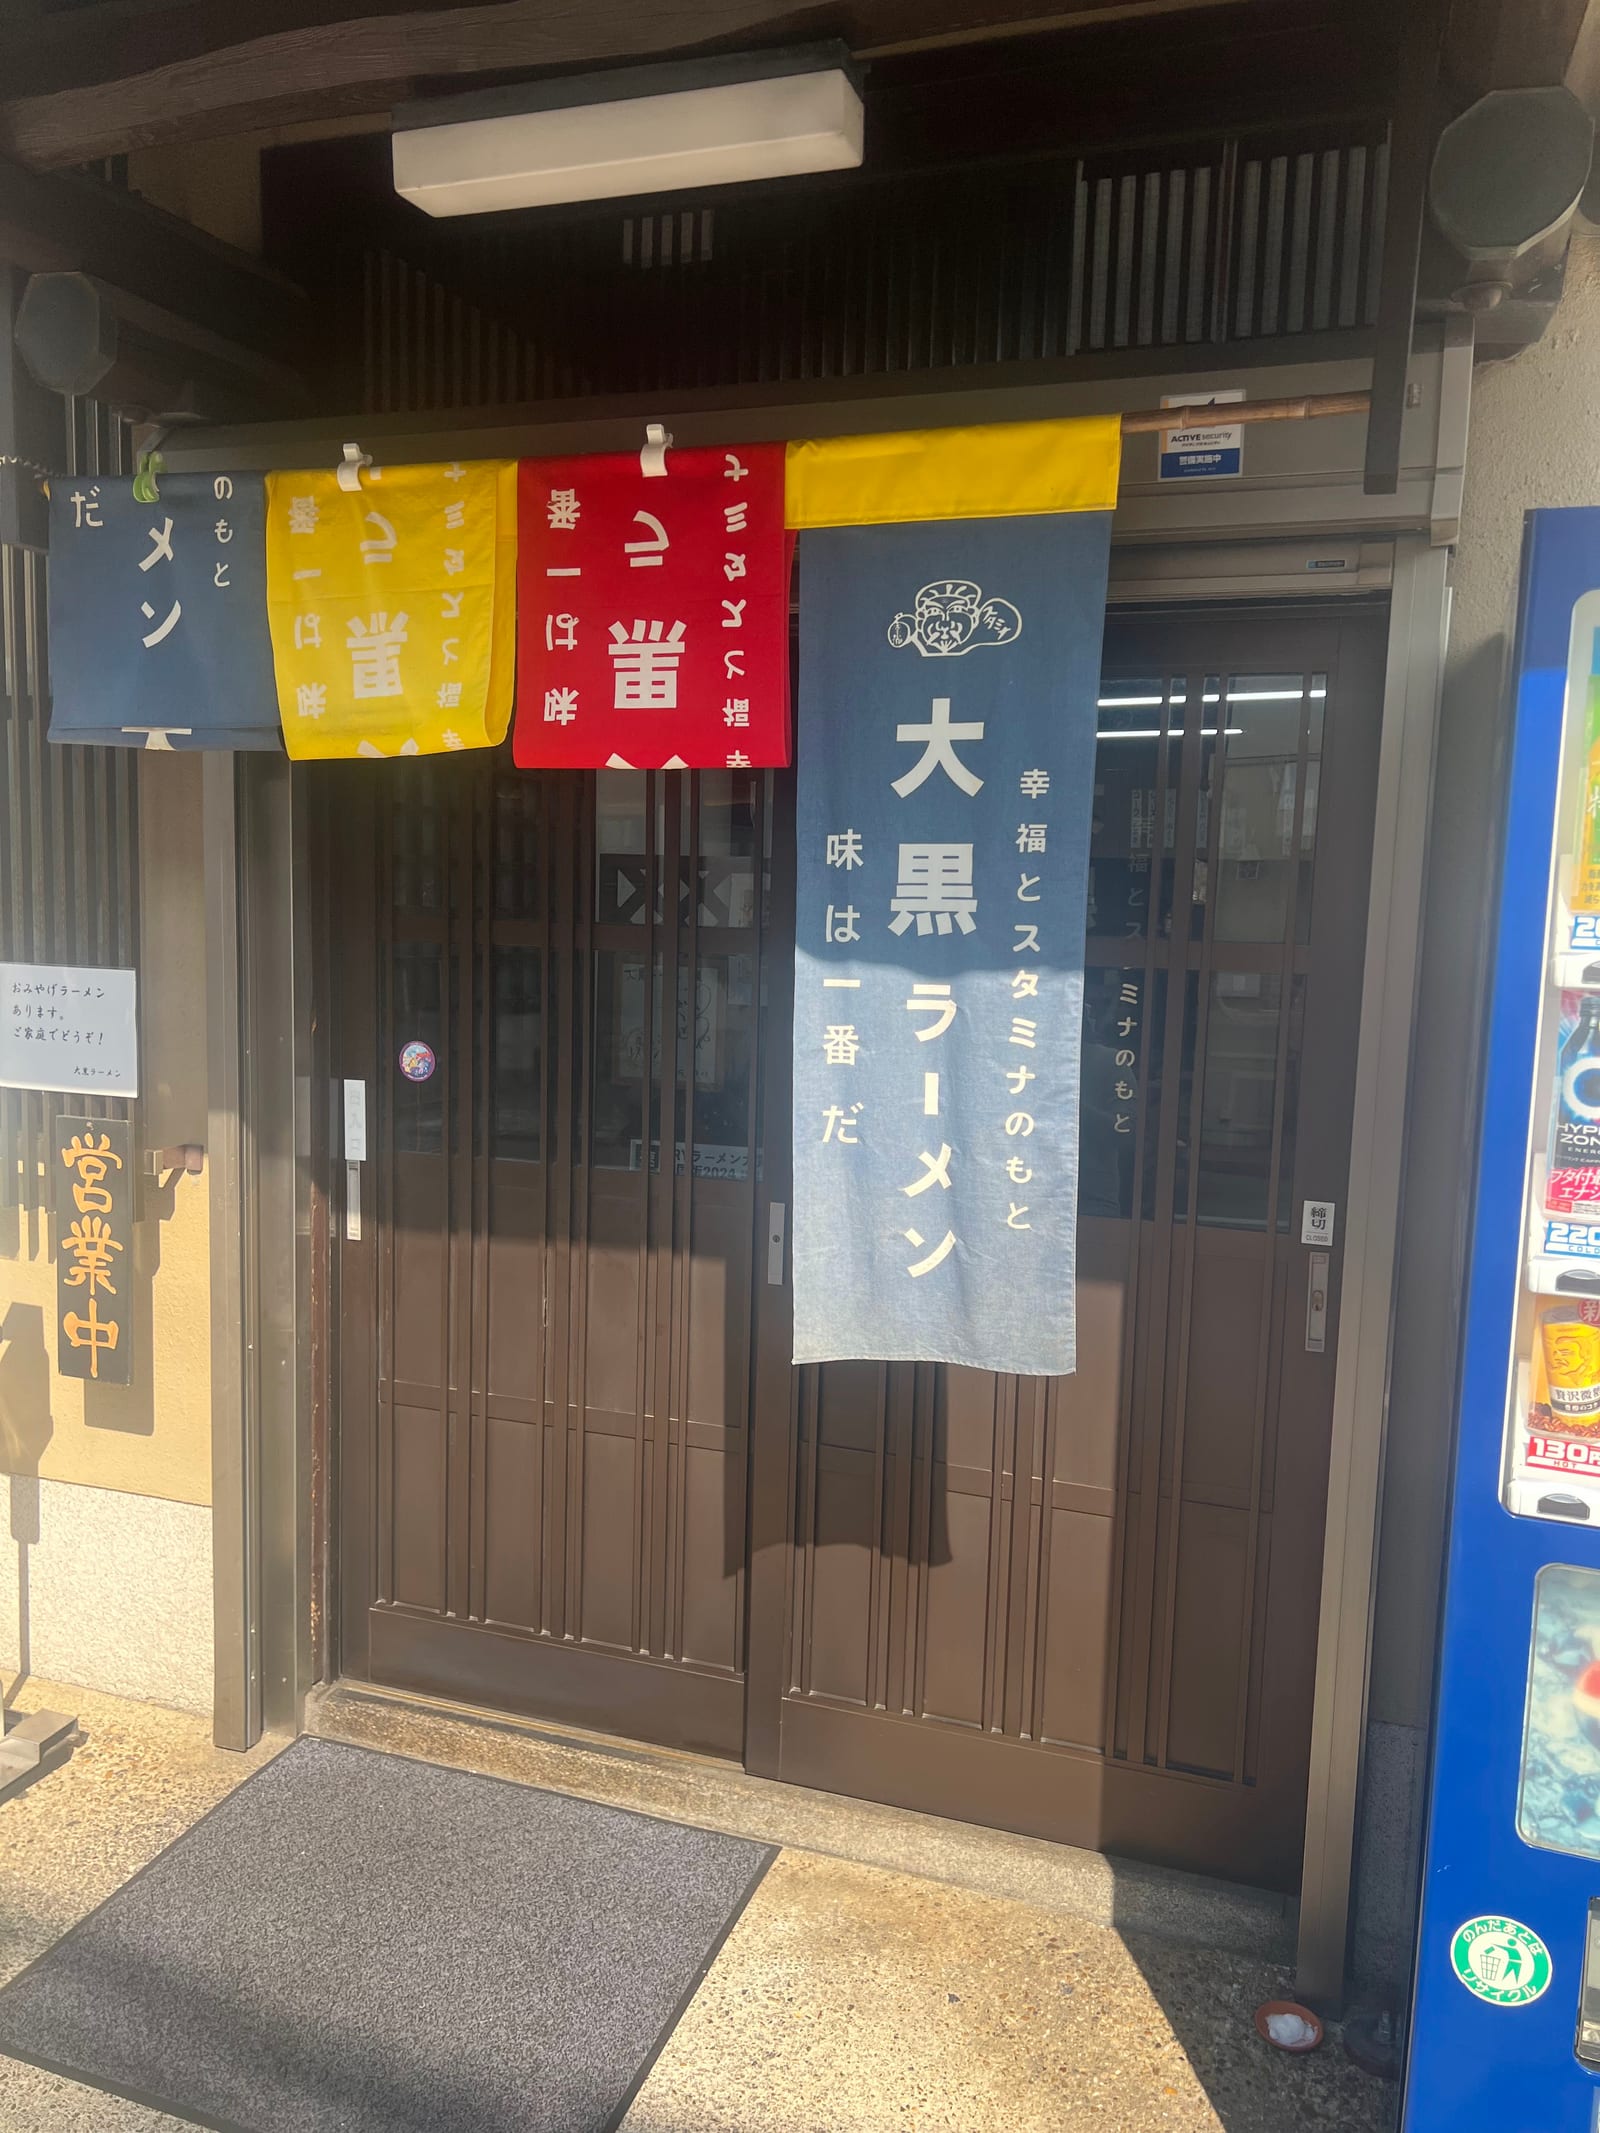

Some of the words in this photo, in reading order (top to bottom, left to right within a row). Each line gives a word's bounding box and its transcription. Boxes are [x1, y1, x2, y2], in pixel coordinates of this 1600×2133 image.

[1171, 433, 1201, 443] ACTIVE
[1202, 432, 1233, 444] security
[70, 486, 104, 528] だ
[213, 475, 234, 588] のもと
[138, 517, 182, 649] メン
[12, 982, 105, 998] おみやげラーメン
[822, 829, 865, 1145] 味は一番だ
[887, 697, 985, 1279] 大黒ラーメン
[1004, 768, 1051, 1231] 幸福とスタミナのもと
[12, 1004, 64, 1020] あります。
[61, 1132, 124, 1379] 営業中
[1553, 1460, 1577, 1469] HOT
[1462, 1919, 1544, 1957] のんだあとは
[1461, 1968, 1537, 2003] リサイクル
